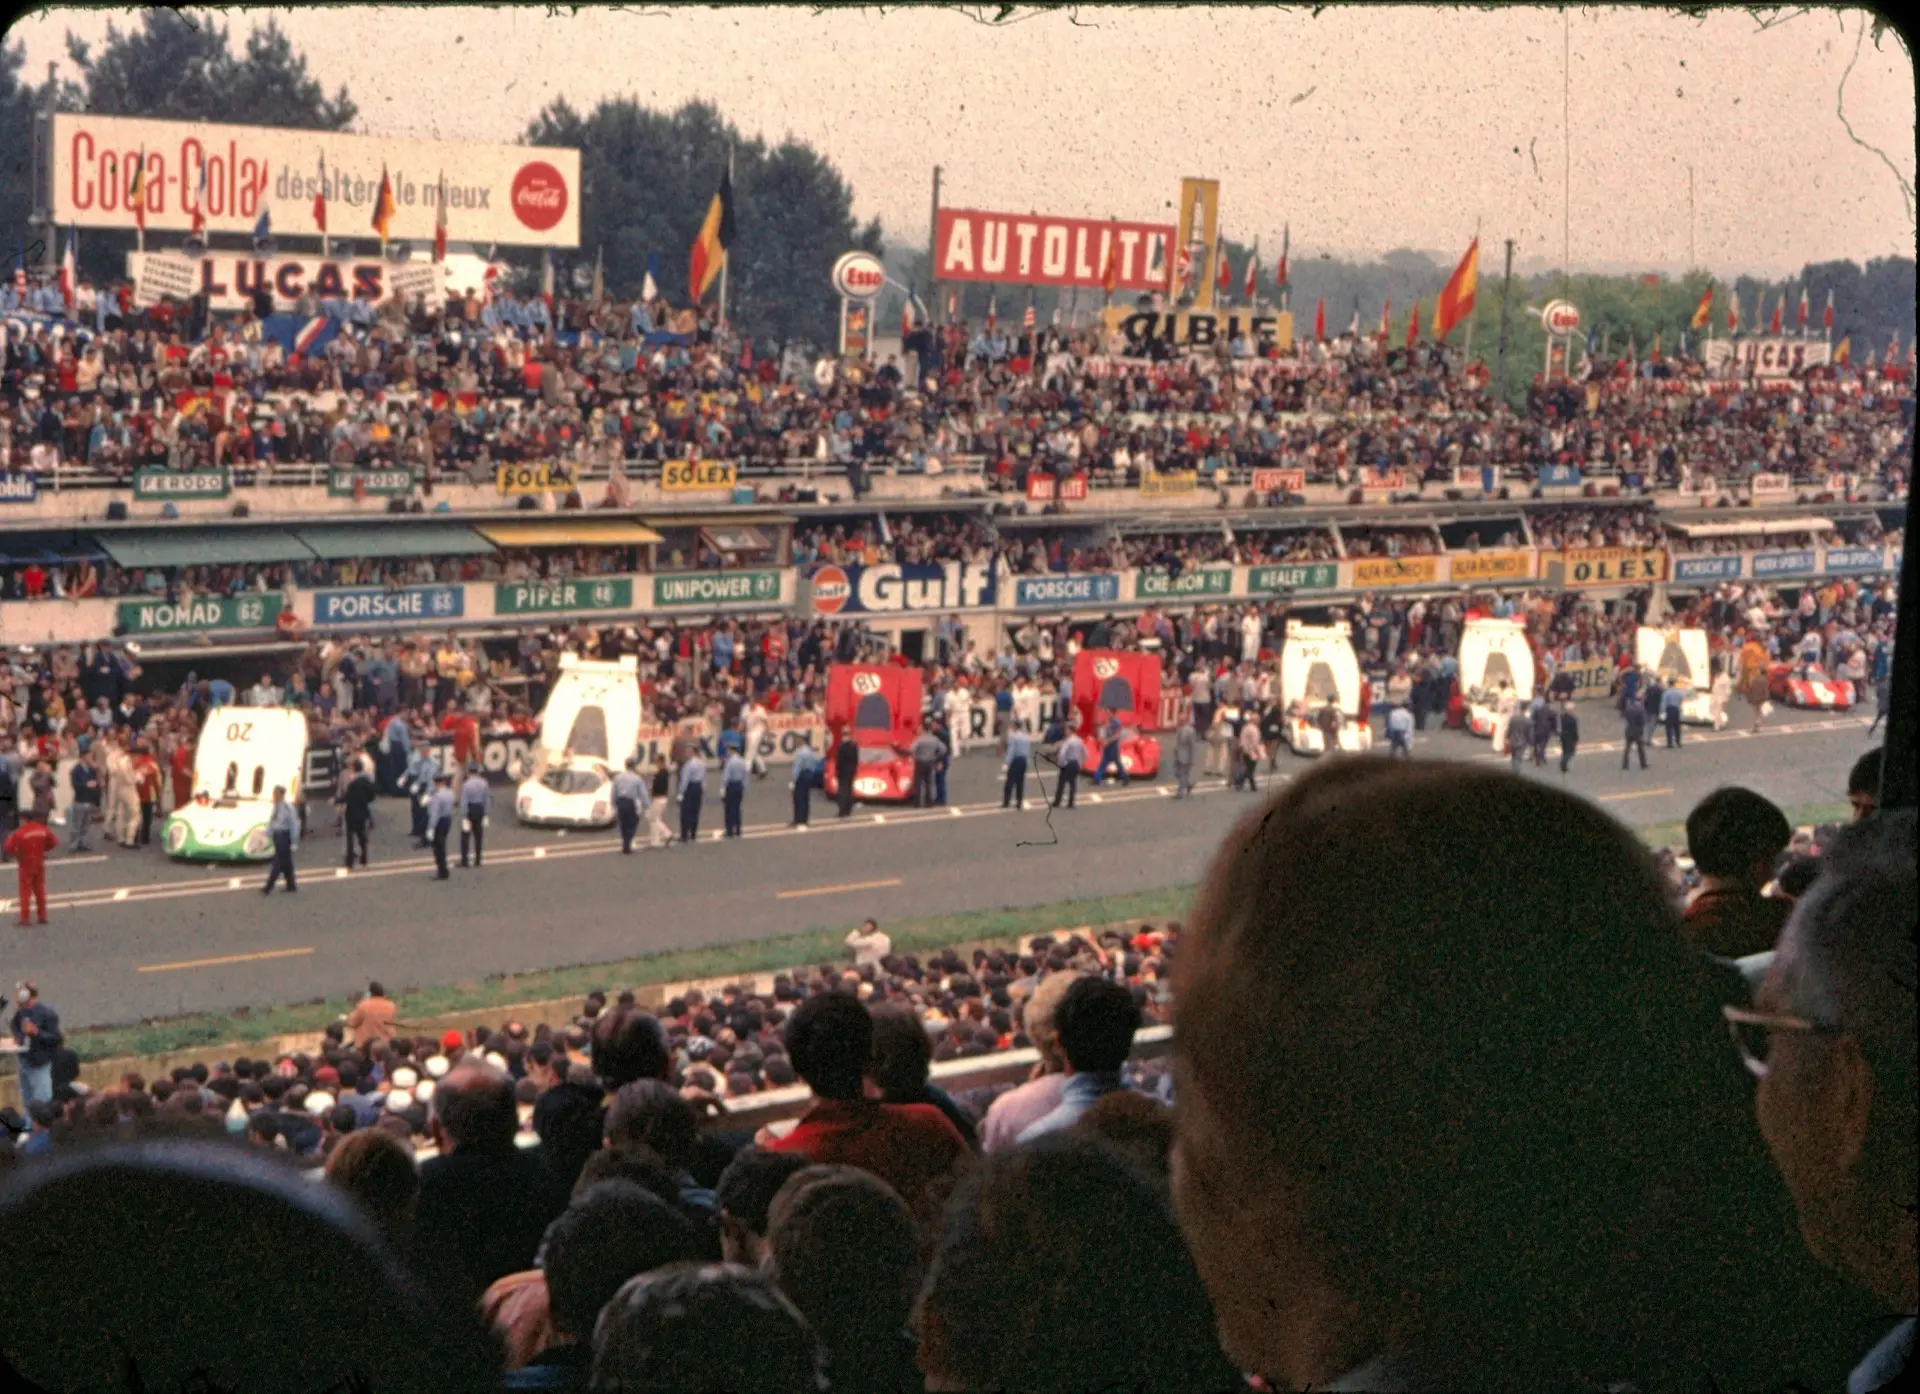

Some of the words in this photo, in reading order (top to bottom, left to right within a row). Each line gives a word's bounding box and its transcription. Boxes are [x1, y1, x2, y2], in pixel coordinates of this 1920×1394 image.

[72, 130, 259, 218] Coca-Cola
[275, 165, 387, 206] désaltèr
[395, 171, 416, 206] le
[944, 218, 1167, 282] AUTOLITE
[201, 257, 384, 300] LUCAS
[847, 267, 884, 287] Esso
[142, 475, 222, 492] FERODO
[667, 465, 732, 485] SOLEX
[1259, 568, 1307, 588] HEALEY
[1573, 558, 1656, 581] OLEX
[662, 576, 751, 601] UNIPOWER
[858, 559, 991, 612] Gulf
[1025, 579, 1092, 600] PORSCHE
[1143, 572, 1205, 593] CHERON
[327, 593, 422, 617] PORSCHE
[515, 585, 576, 609] PIPER
[140, 602, 221, 628] NOMAD
[226, 722, 253, 742] 20
